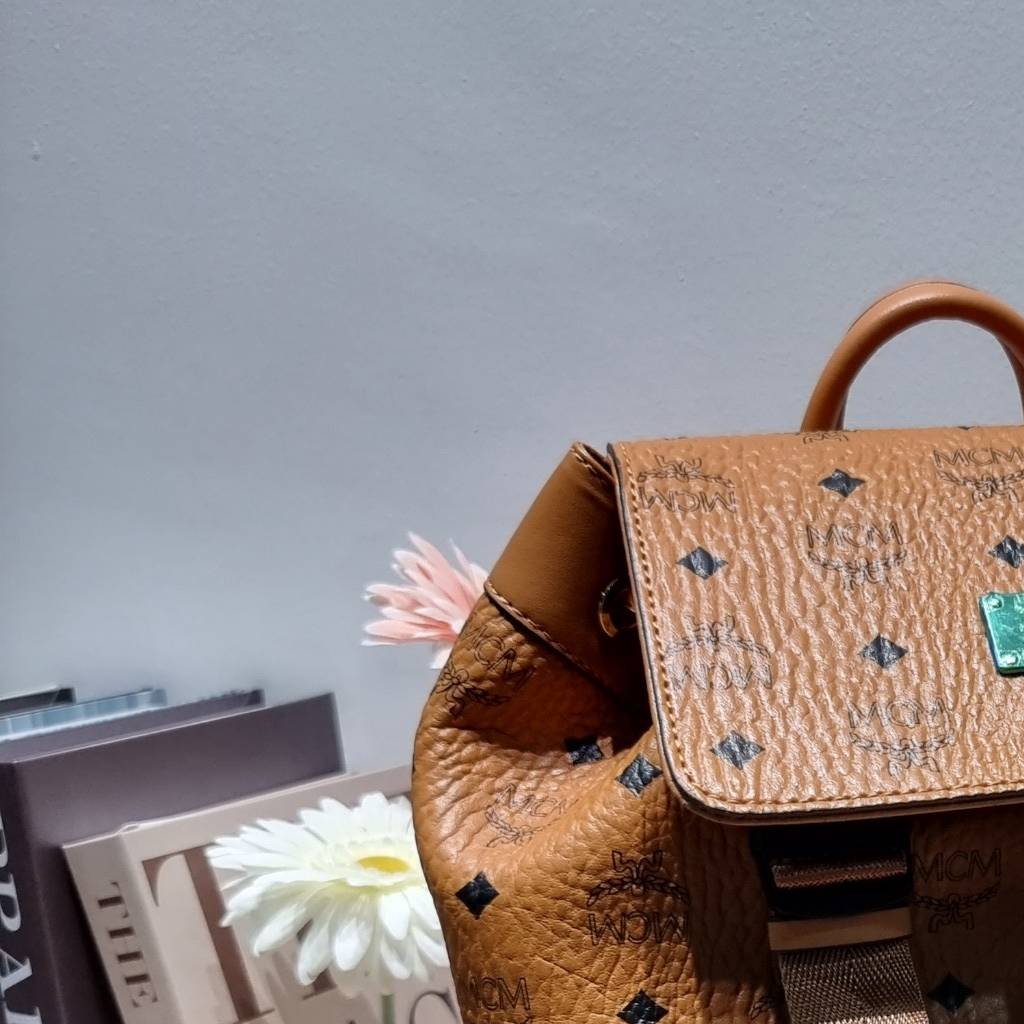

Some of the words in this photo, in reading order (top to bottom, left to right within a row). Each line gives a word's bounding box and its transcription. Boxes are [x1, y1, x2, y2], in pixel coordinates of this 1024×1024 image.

[638, 486, 737, 514] MCM
[807, 521, 905, 549] MCM
[911, 848, 1001, 882] MCM
[98, 881, 157, 1008] THE
[588, 911, 689, 946] MCM
